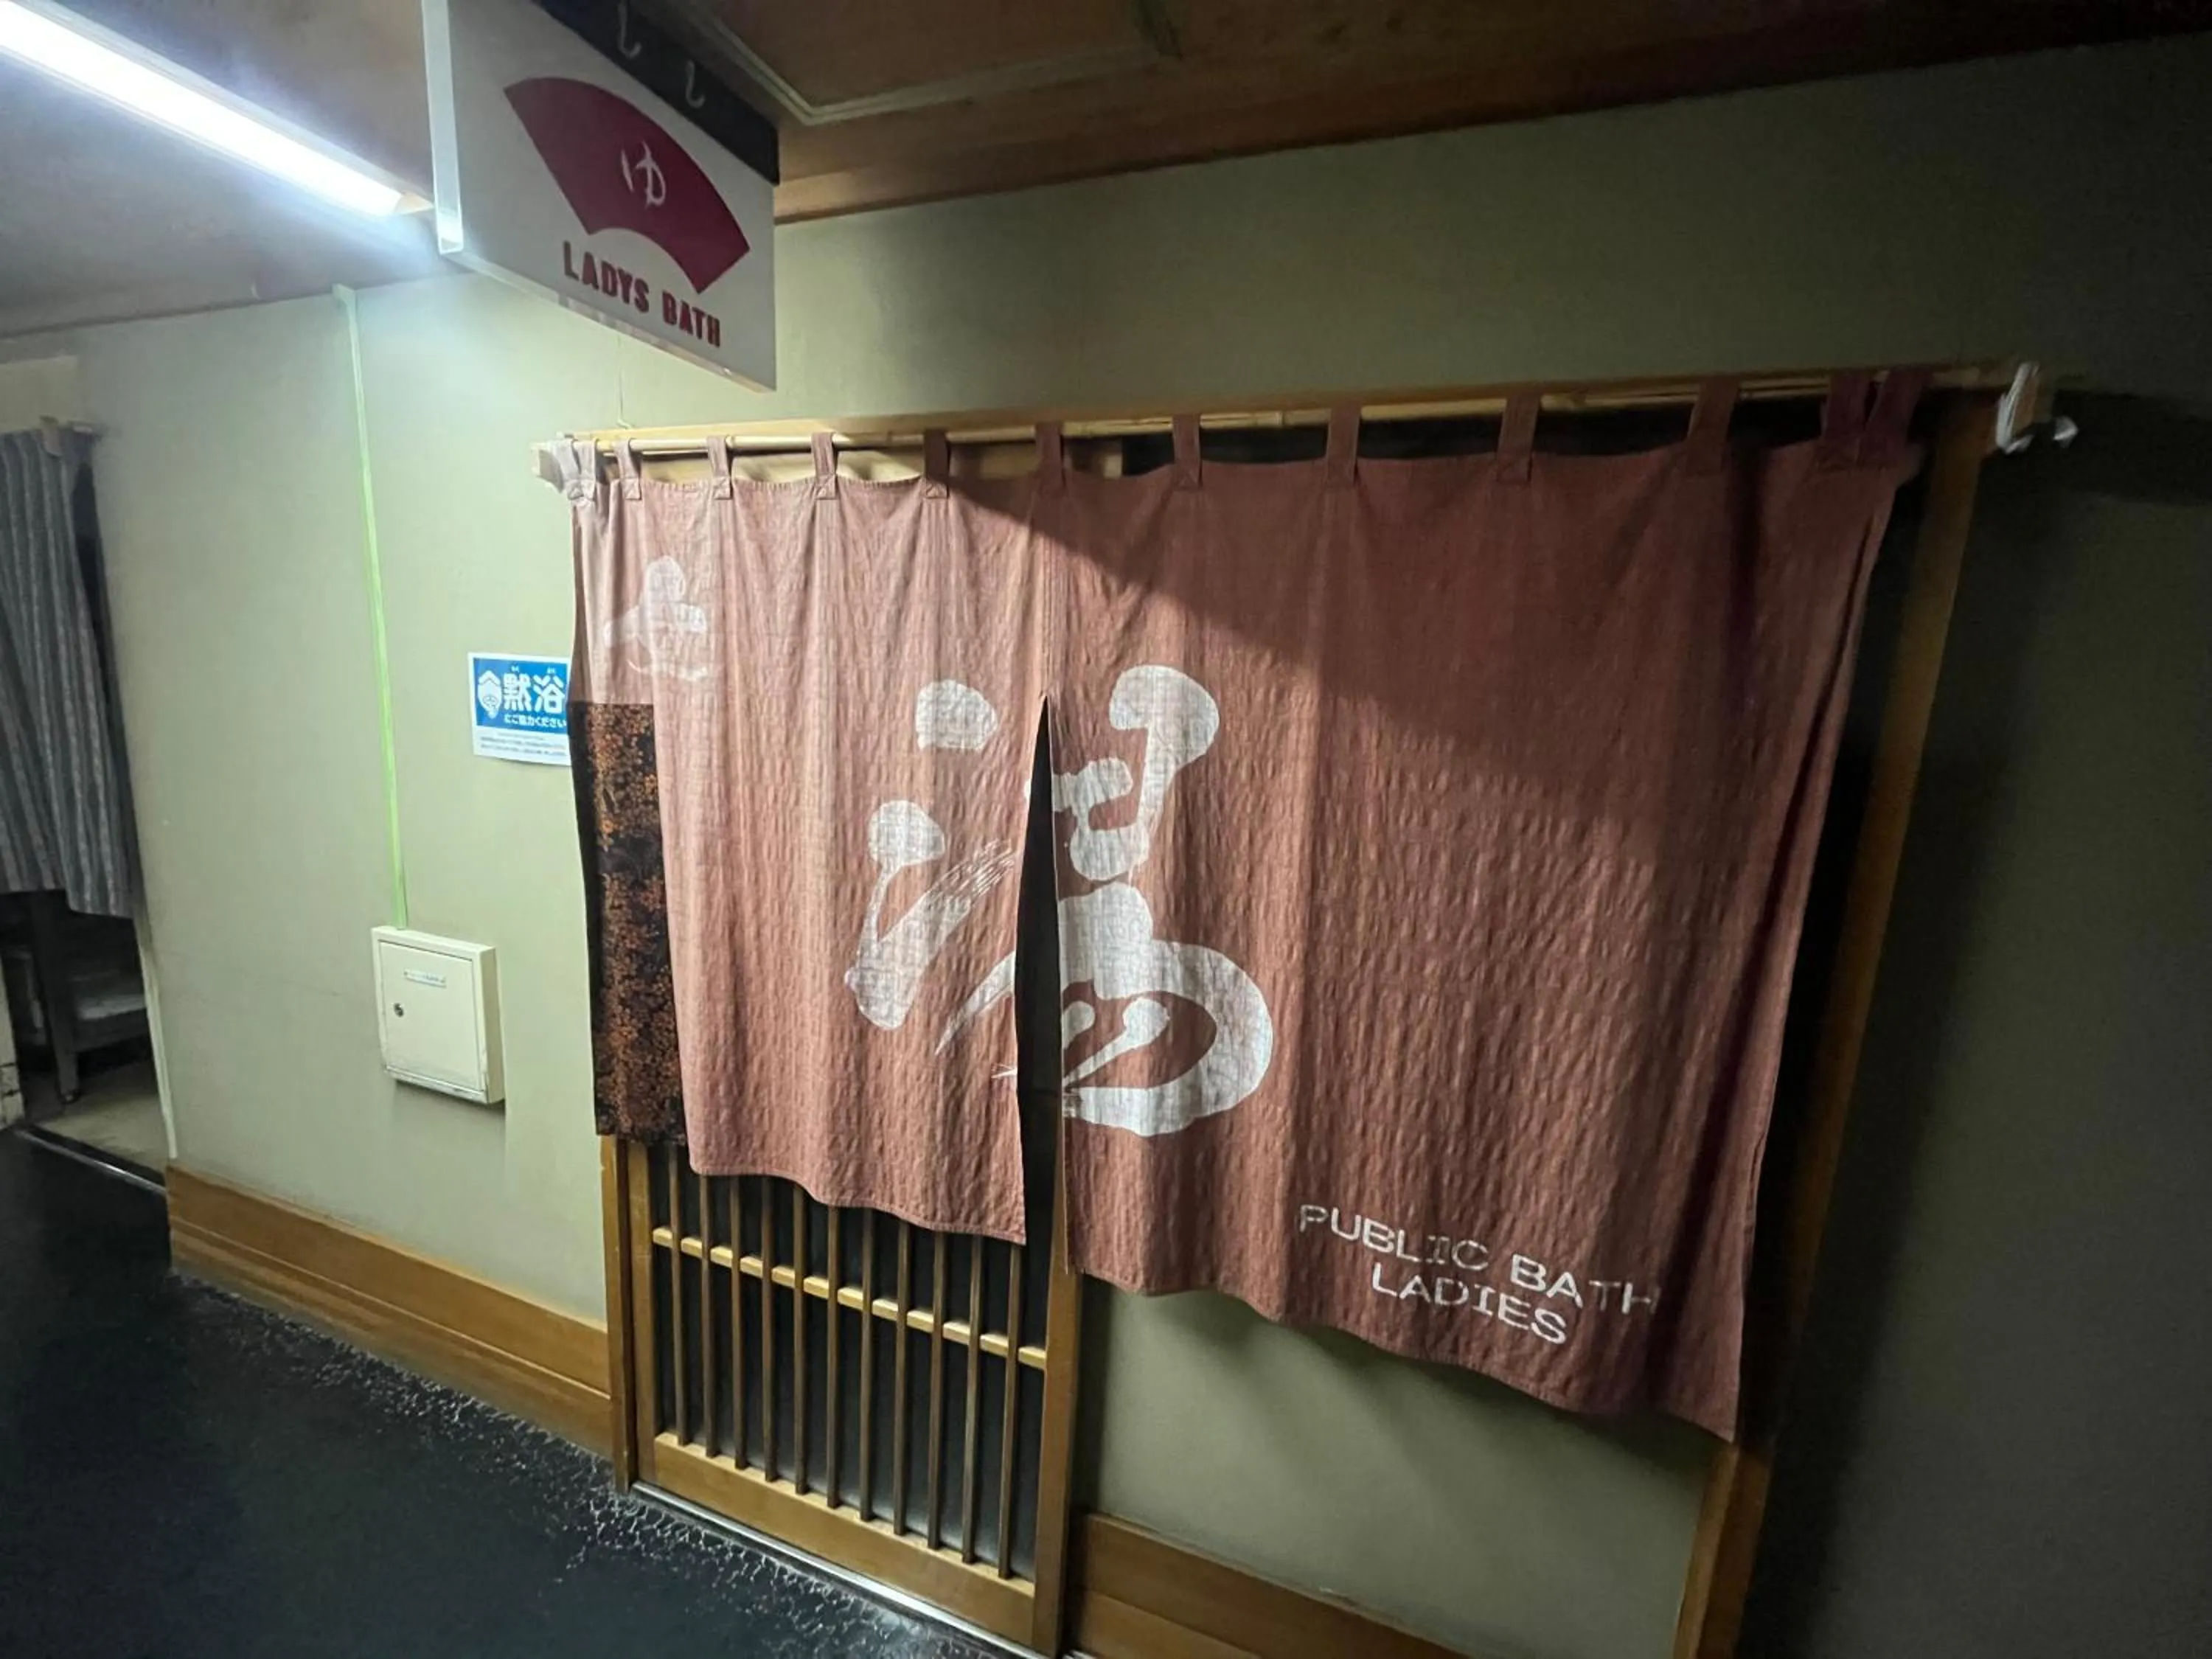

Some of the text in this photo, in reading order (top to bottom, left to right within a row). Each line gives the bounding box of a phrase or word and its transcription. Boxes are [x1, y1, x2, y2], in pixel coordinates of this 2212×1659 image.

[620, 141, 667, 208] ゆ
[563, 240, 721, 348] LADYS BATH
[503, 672, 566, 714] 黙浴
[1298, 1204, 1661, 1315] PUBLIC BATH
[1371, 1262, 1567, 1345] LADIES
